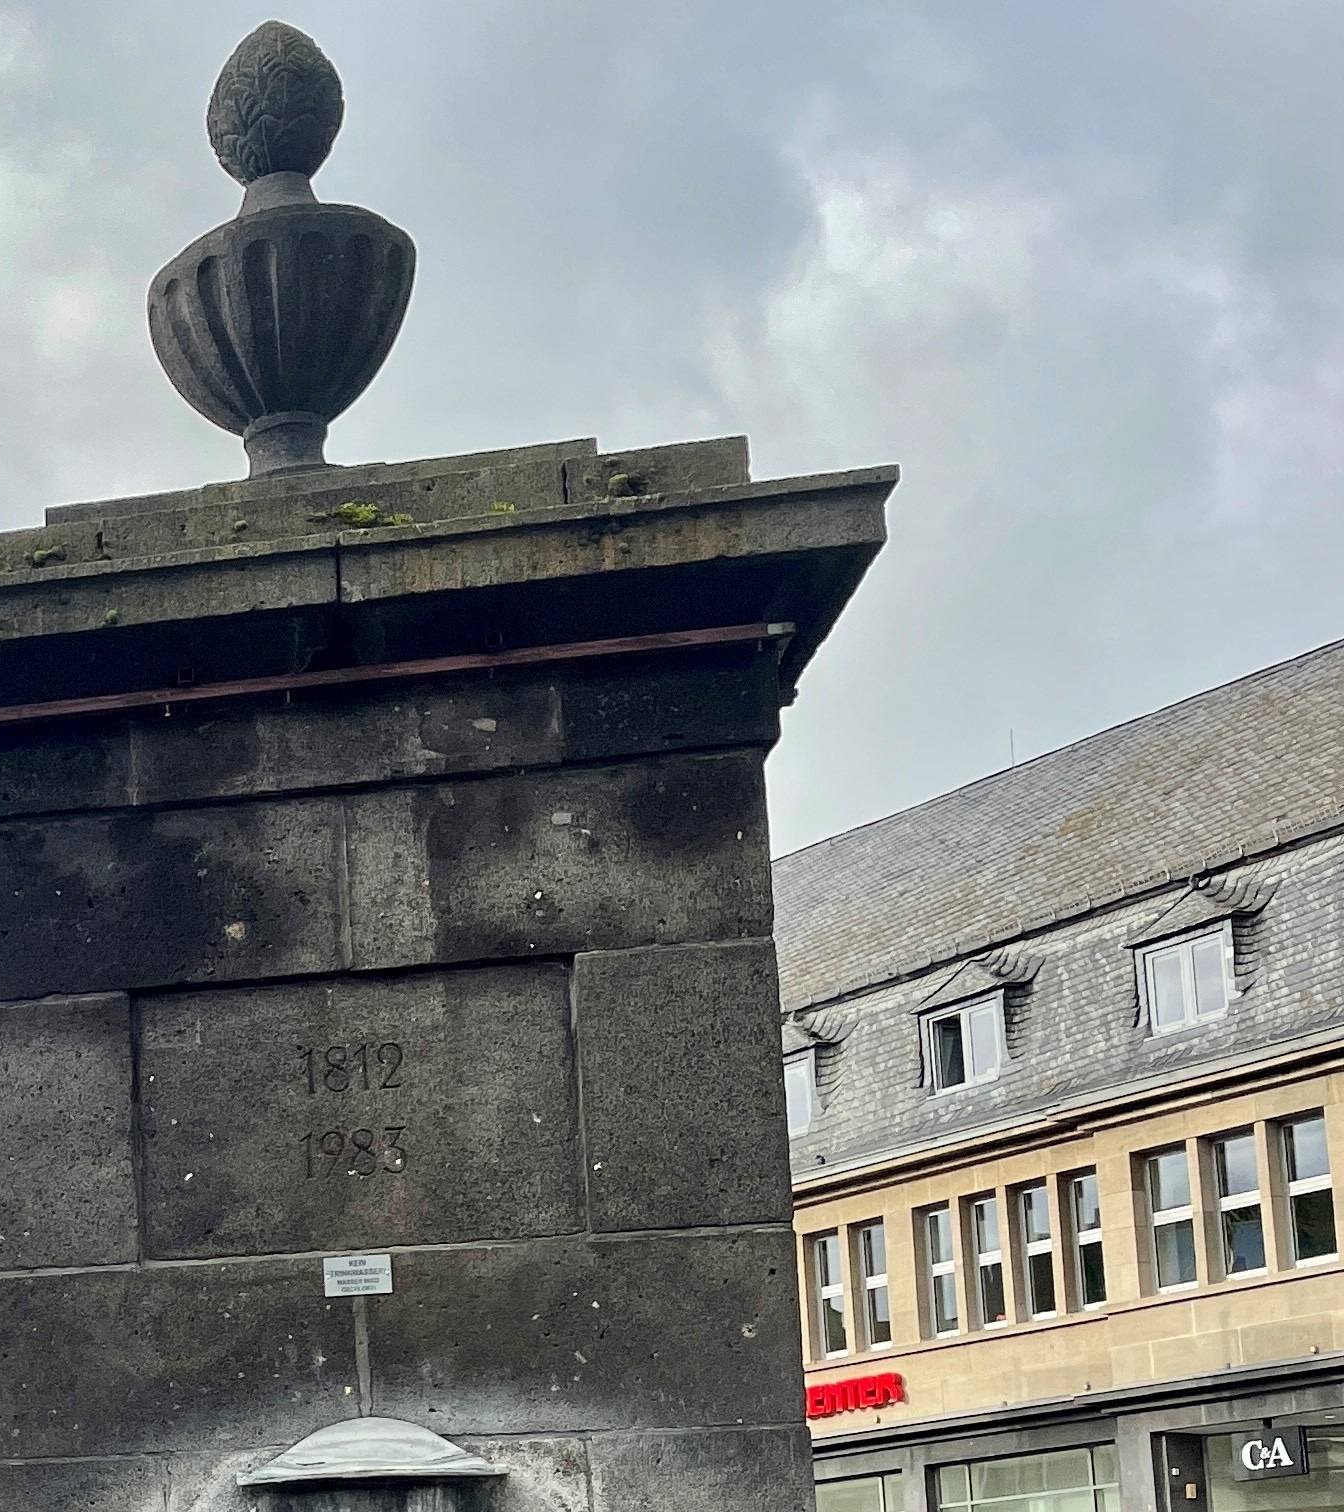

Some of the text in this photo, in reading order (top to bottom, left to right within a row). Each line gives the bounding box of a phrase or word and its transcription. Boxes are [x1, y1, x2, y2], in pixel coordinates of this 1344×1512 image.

[297, 1042, 404, 1094] 1812
[297, 1126, 407, 1179] 1983
[1241, 1437, 1294, 1470] C&A
